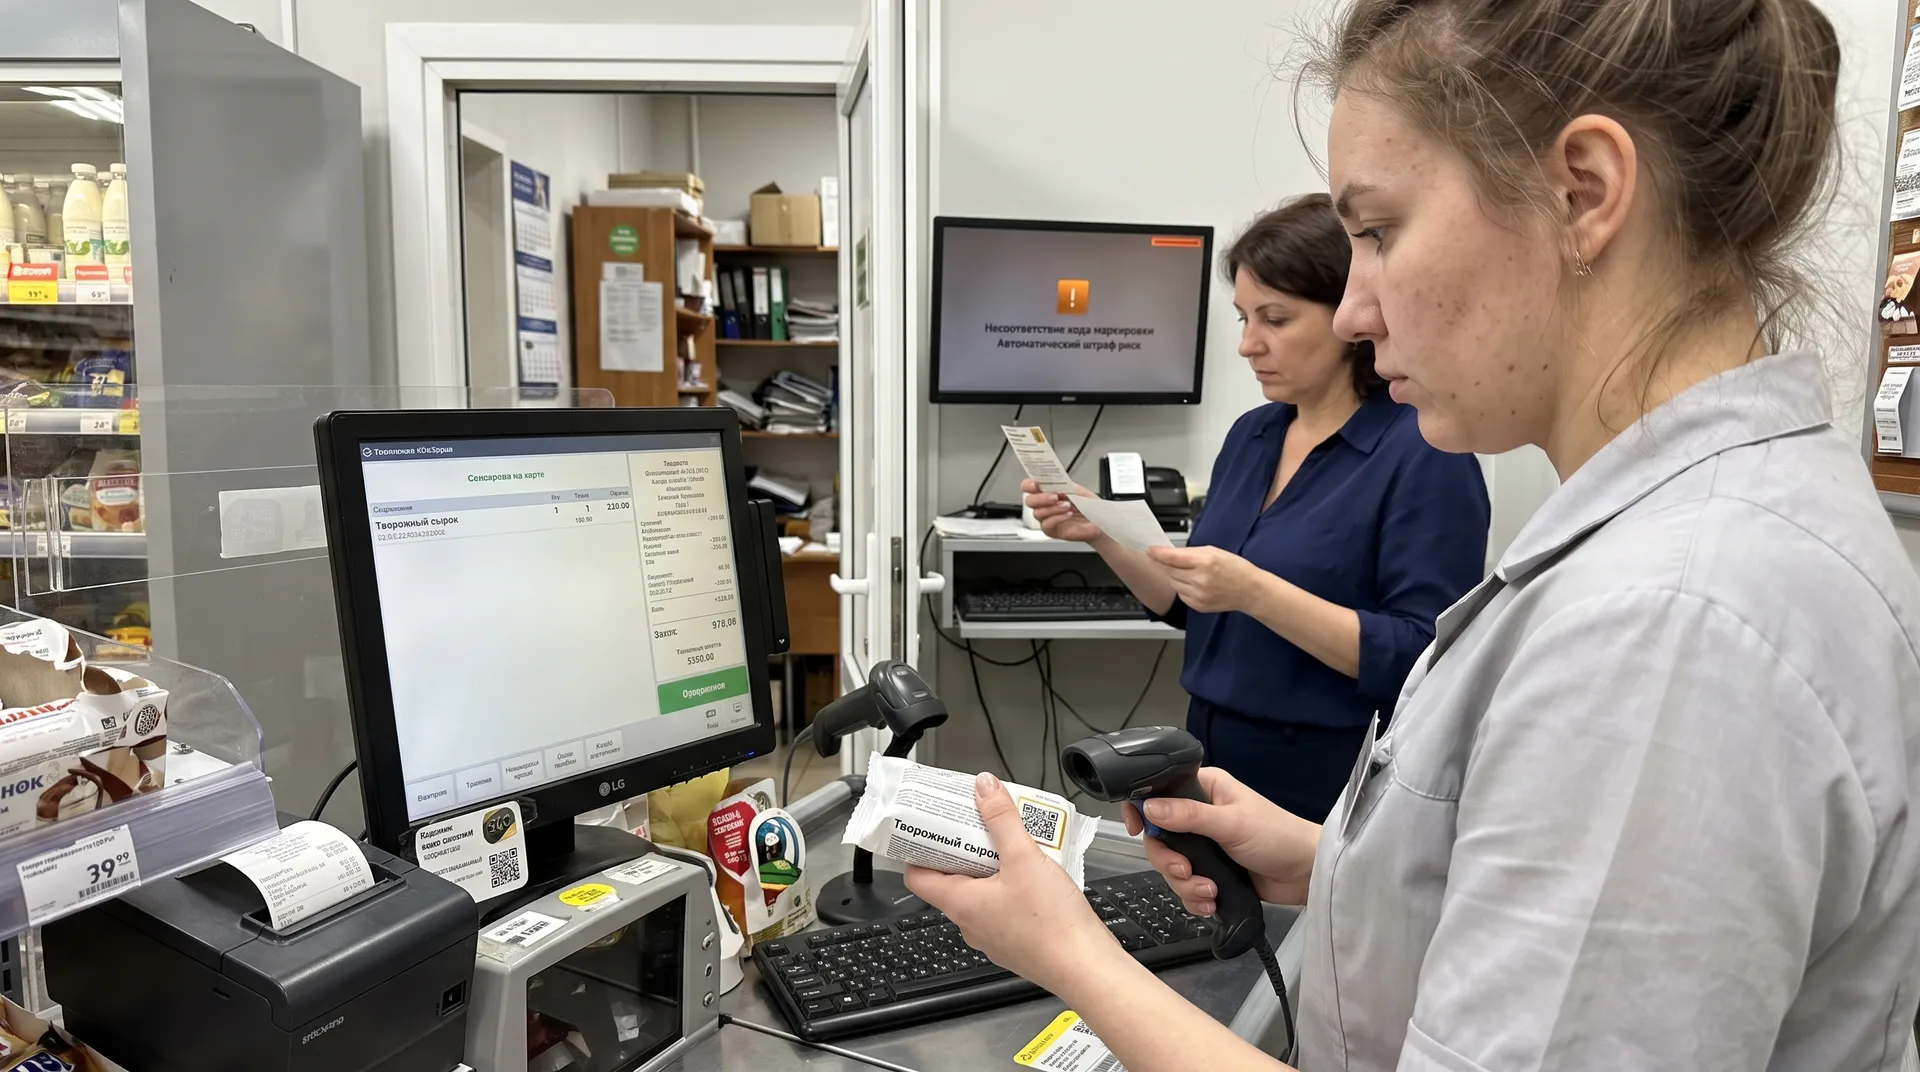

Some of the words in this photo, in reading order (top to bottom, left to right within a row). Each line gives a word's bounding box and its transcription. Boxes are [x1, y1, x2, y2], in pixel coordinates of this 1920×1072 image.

[985, 323, 1065, 335] Несоответствие
[1068, 325, 1091, 336] кода
[1093, 325, 1154, 338] маркировки
[997, 338, 1081, 350] Автоматический
[1083, 340, 1116, 352] штраф
[1118, 342, 1141, 353] риск
[375, 517, 429, 531] Творожный
[430, 516, 459, 526] сырок
[611, 778, 626, 792] LG
[894, 817, 962, 849] Творожный
[963, 842, 1000, 861] сырок
[86, 857, 116, 885] 39
[115, 851, 130, 863] 99
